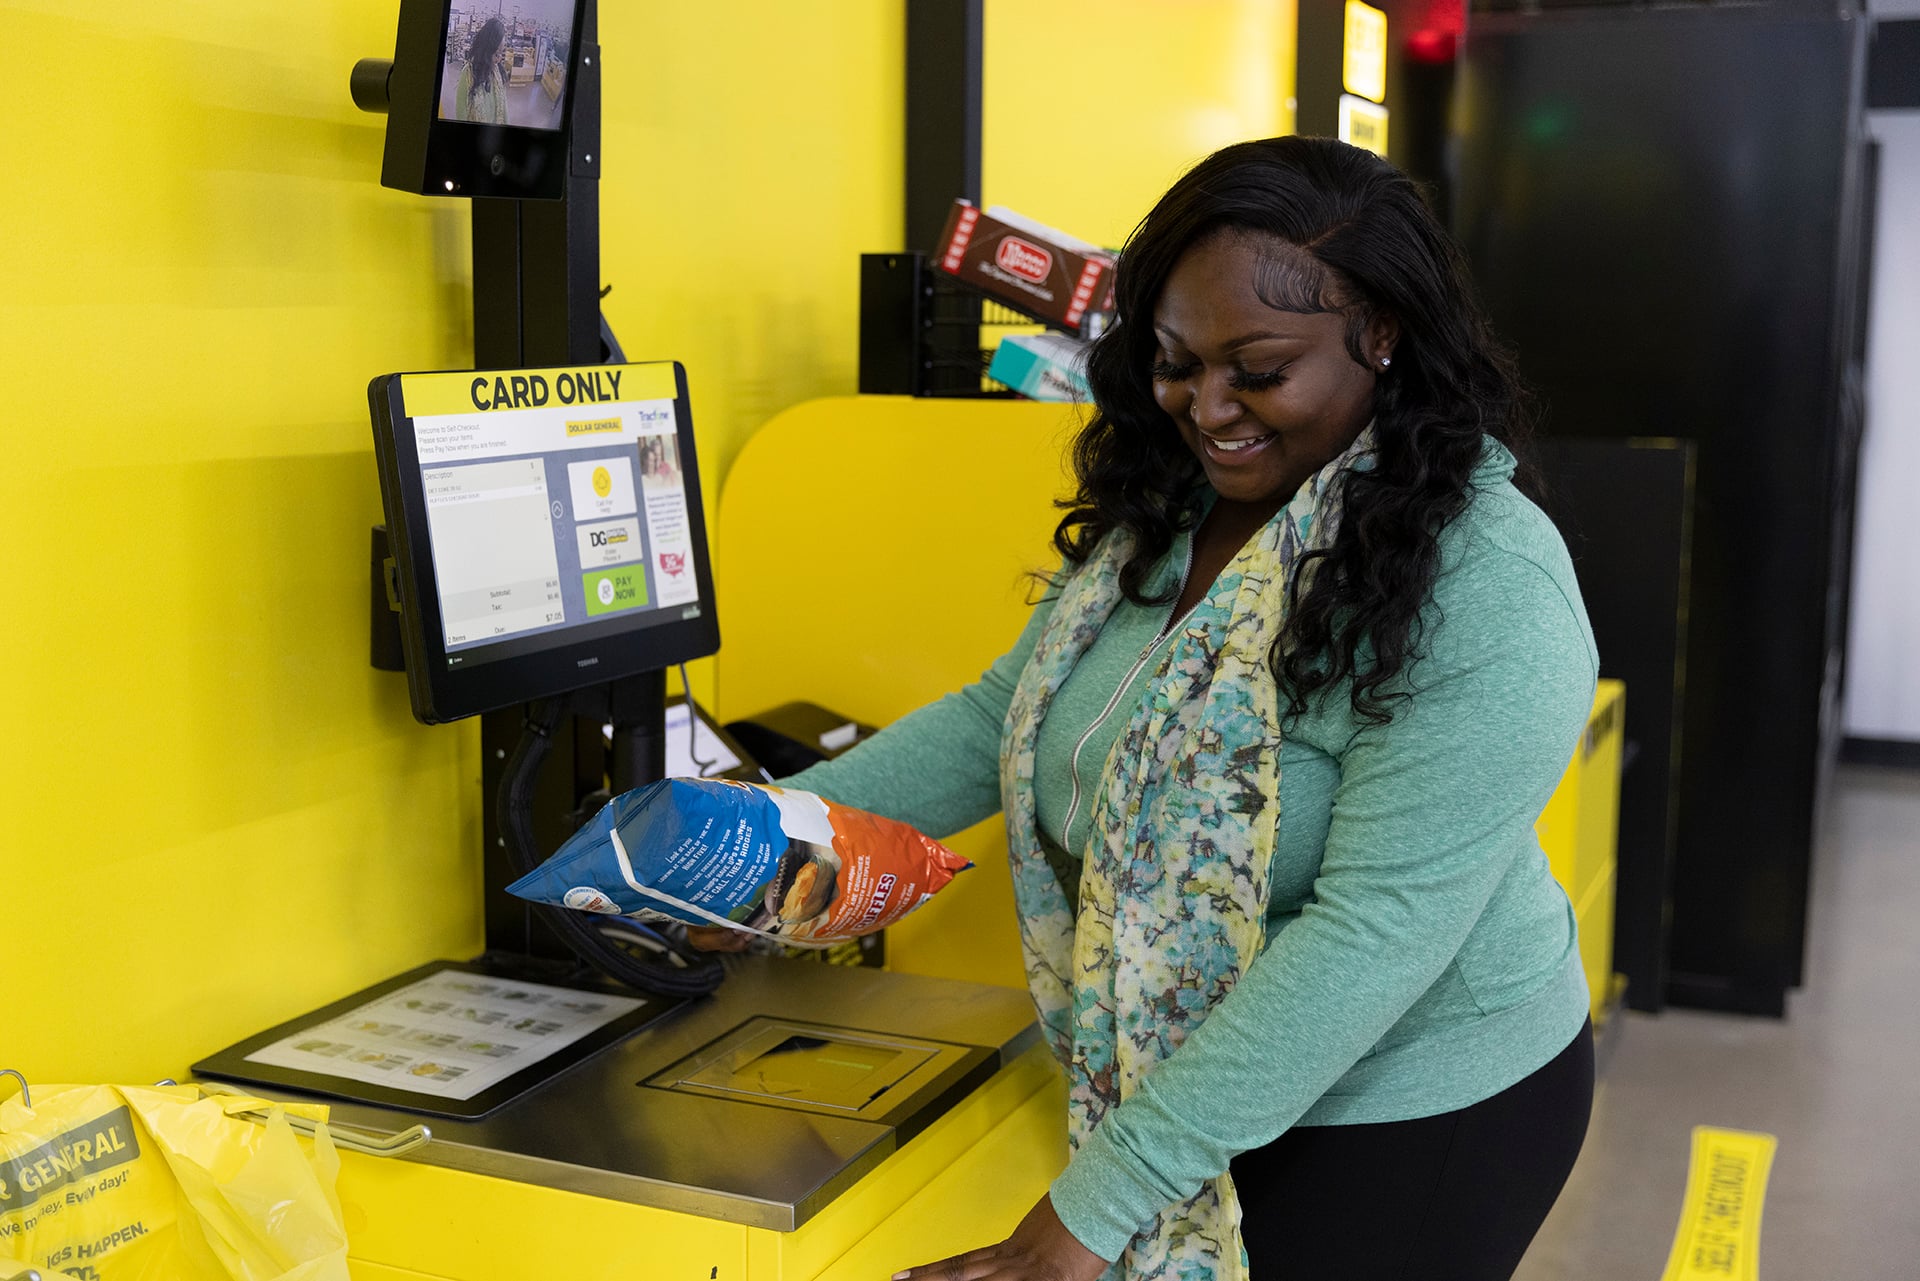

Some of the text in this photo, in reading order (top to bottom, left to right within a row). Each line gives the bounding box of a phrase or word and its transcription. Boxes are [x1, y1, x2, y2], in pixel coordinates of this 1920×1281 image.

[471, 371, 622, 411] CARD ONLY
[568, 422, 619, 433] DOLLAR GENERAL
[590, 531, 607, 547] DG
[616, 577, 632, 586] PAY
[616, 588, 636, 600] NOW
[546, 611, 562, 621] $7.05
[665, 851, 680, 864] Look
[682, 838, 693, 848] you
[716, 843, 725, 854] FOR
[722, 829, 731, 842] YOUR
[682, 844, 709, 871] HIGH FIVE!
[701, 826, 752, 903] WE CALL THEM RIDGES
[716, 864, 731, 878] HAVE
[750, 877, 759, 886] AS
[756, 865, 766, 876] THE
[725, 891, 737, 902] AND
[734, 881, 746, 891] THE
[743, 865, 758, 881] LOWS
[850, 893, 858, 906] ARE
[856, 874, 895, 929] RUFFLES
[99, 1172, 127, 1192] day!
[77, 1221, 149, 1259] HAPPEN.
